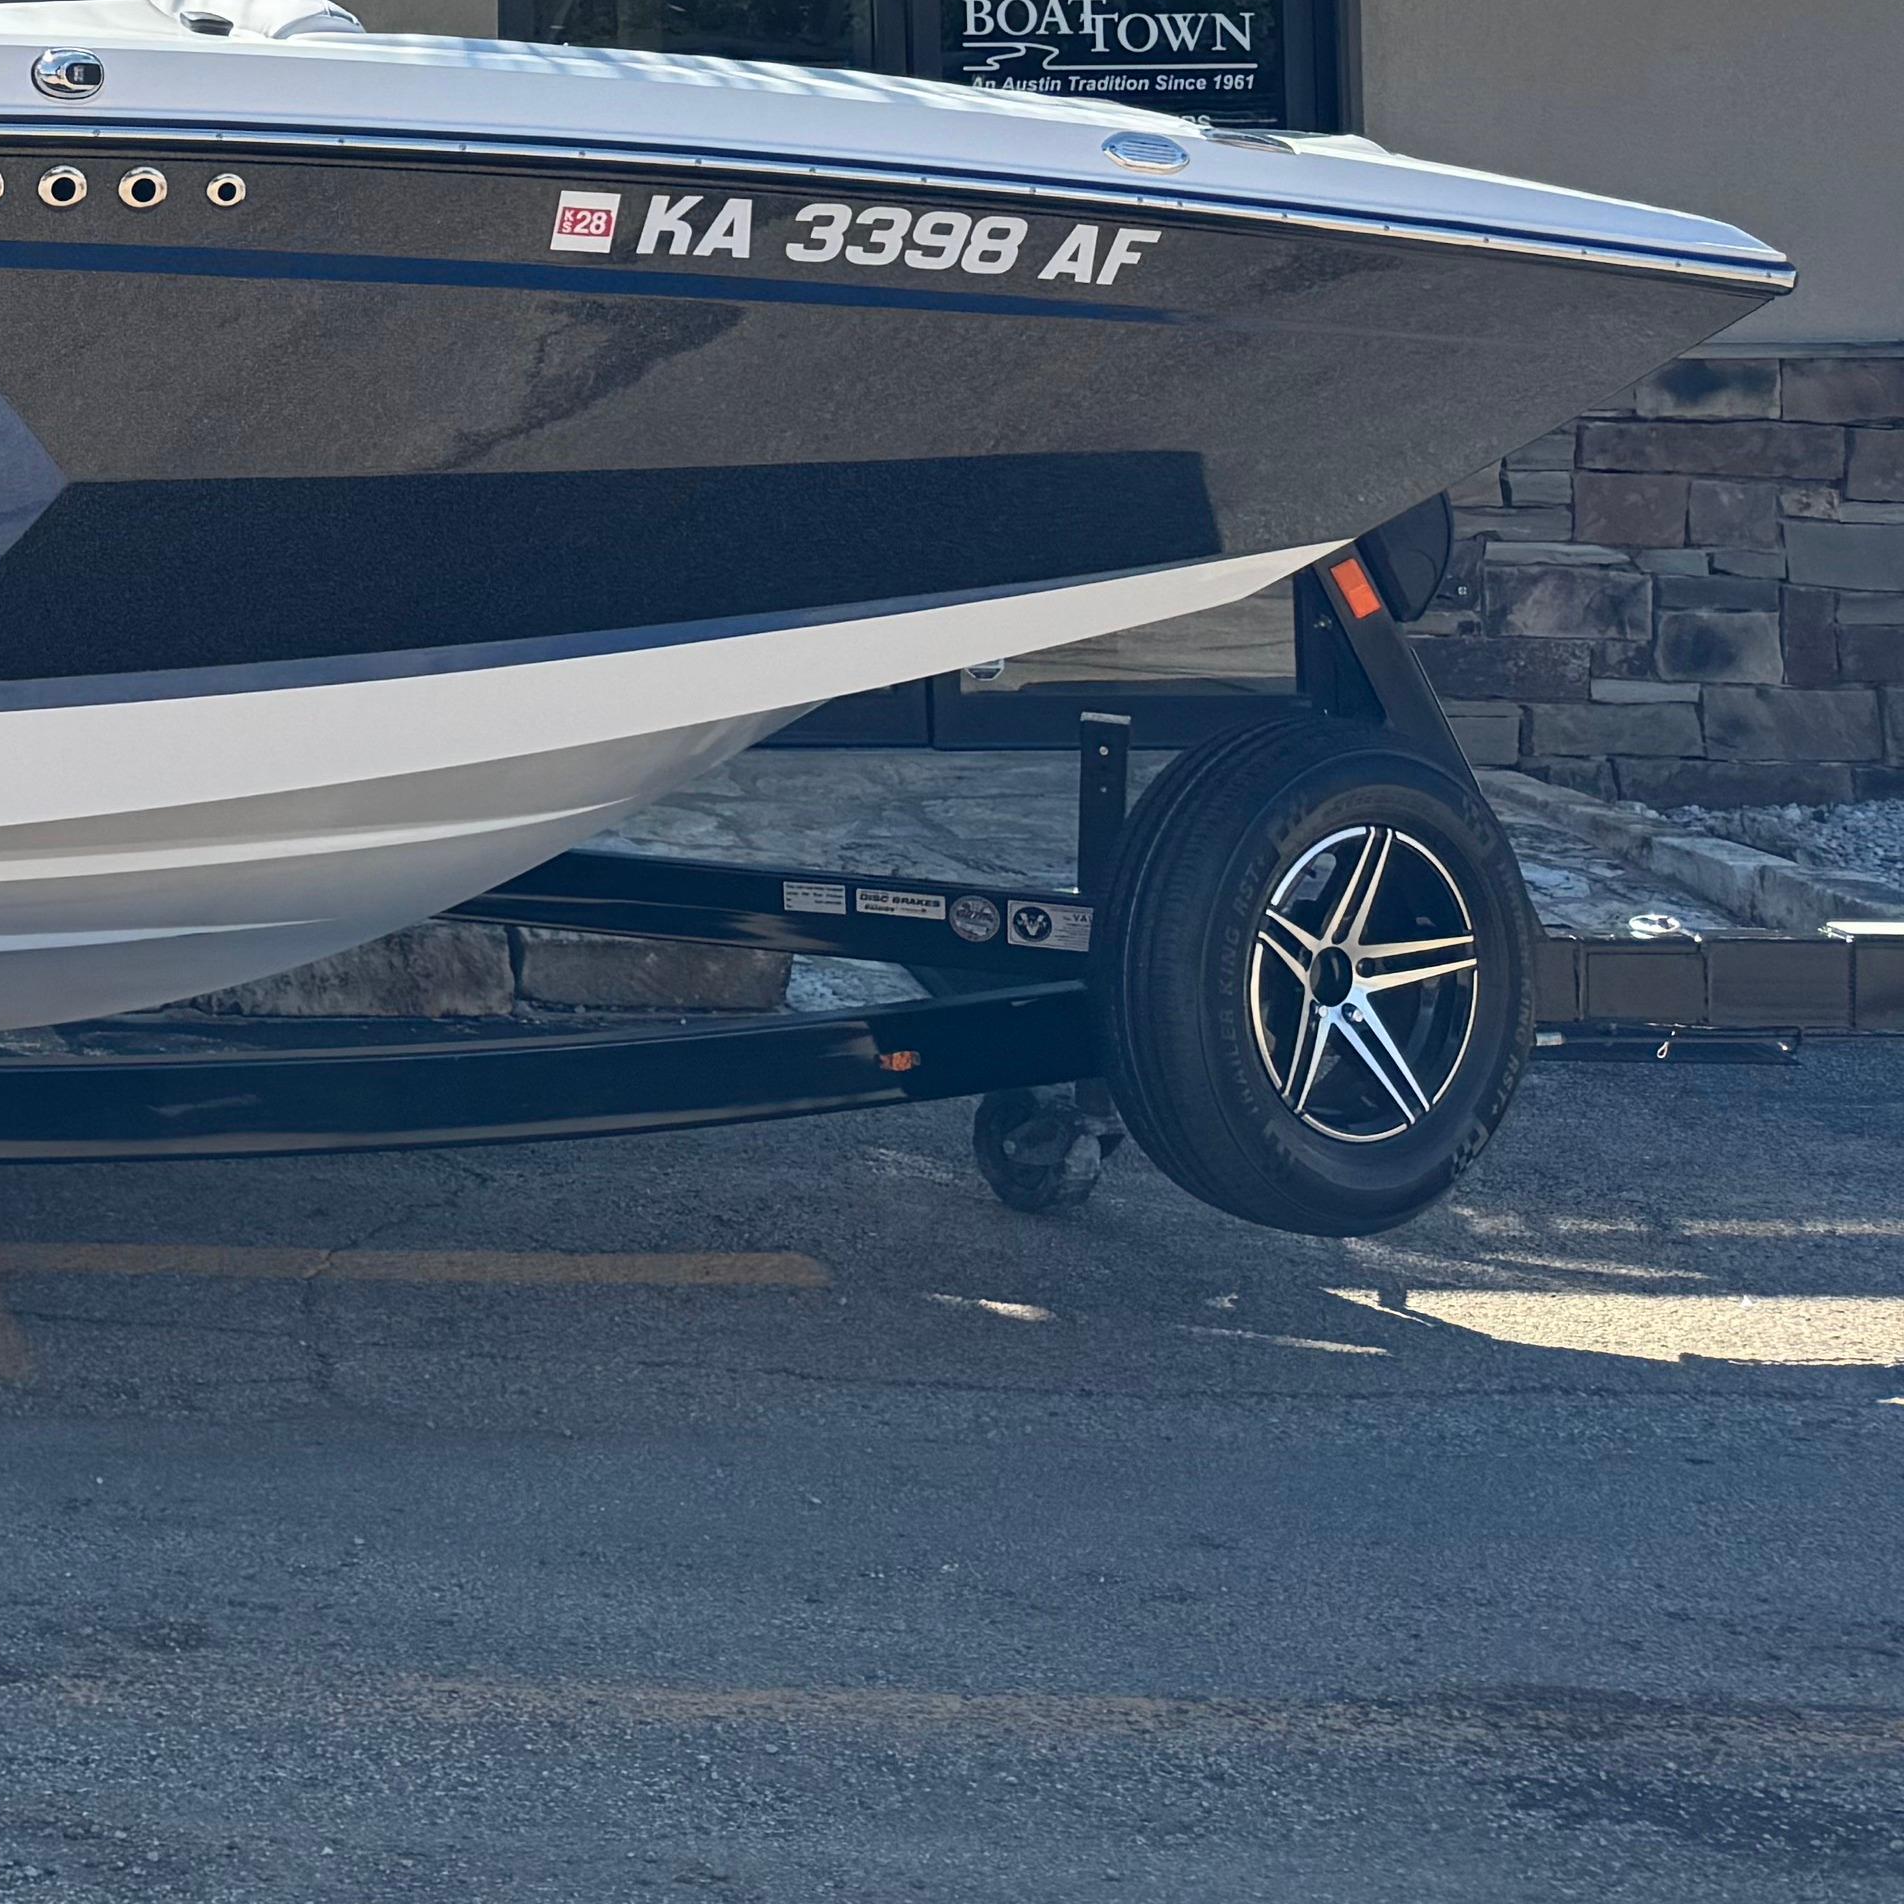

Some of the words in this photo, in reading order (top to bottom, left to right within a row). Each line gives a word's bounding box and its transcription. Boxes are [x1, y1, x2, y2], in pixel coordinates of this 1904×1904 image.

[1080, 12, 1256, 52] TOWN
[971, 77, 996, 89] An
[1002, 75, 1061, 92] Austin
[1069, 75, 1149, 91] Tradition
[1155, 75, 1207, 91] Since
[1213, 74, 1255, 90] 1961
[573, 210, 608, 235] 28
[635, 195, 753, 259] KA
[785, 202, 1029, 274] 3398
[1037, 224, 1162, 286] AF
